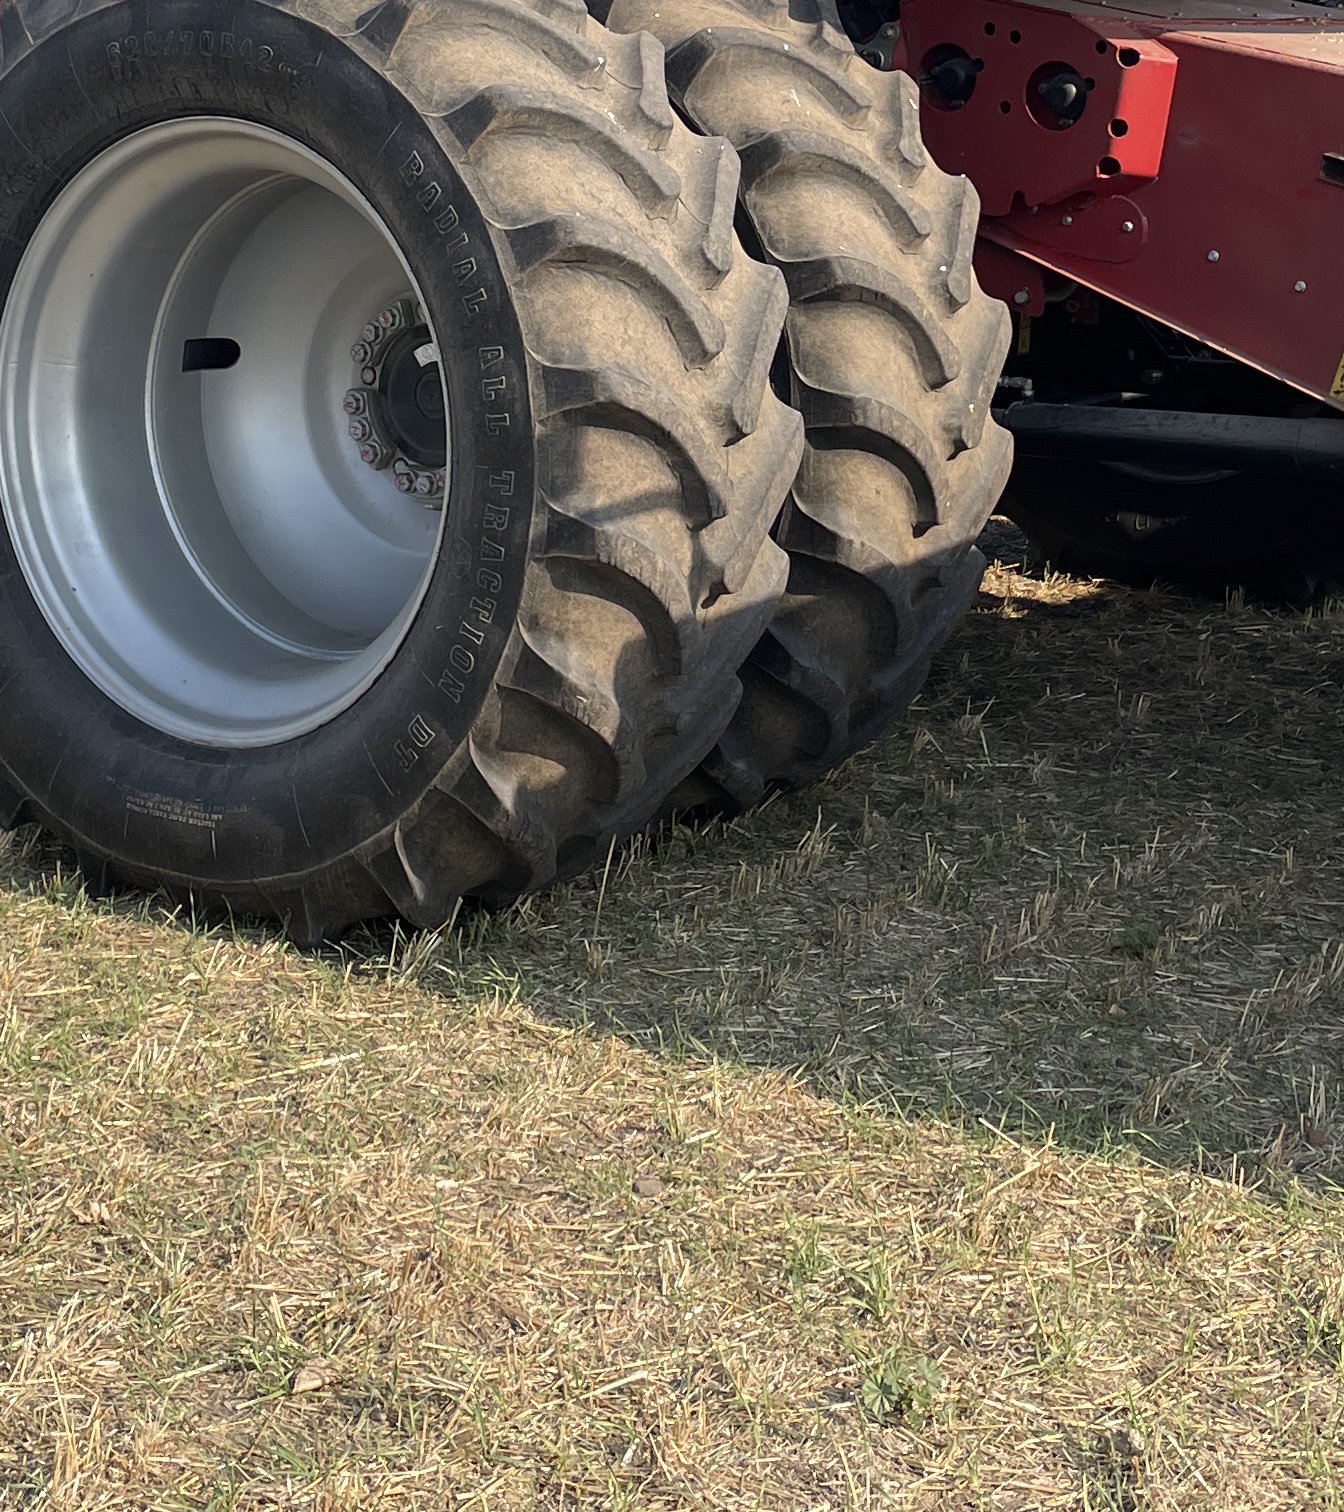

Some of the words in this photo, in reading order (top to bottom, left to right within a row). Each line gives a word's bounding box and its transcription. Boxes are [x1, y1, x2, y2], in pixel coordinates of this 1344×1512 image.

[399, 150, 487, 316] RADIAL
[479, 345, 510, 436] ALL
[438, 470, 515, 703] TRACTION
[393, 714, 435, 771] DT
